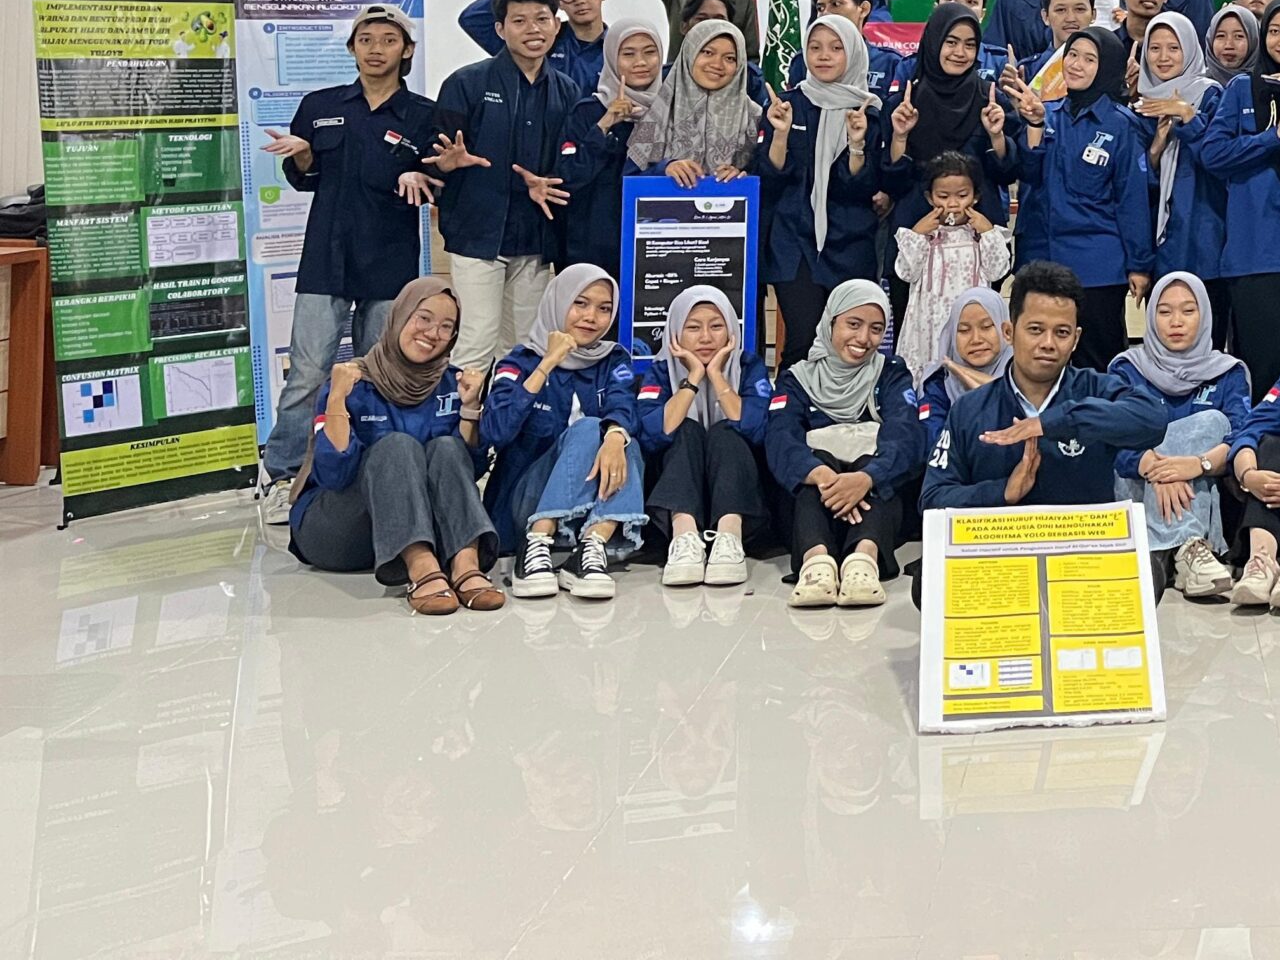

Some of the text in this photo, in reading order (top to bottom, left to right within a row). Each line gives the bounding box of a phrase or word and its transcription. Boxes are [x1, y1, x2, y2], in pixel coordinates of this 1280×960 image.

[244, 3, 315, 11] MENGGUNAKAN
[168, 134, 213, 142] TEKNOLOGI
[65, 145, 99, 153] TUJUAN
[151, 204, 232, 215] METODE PENELITIAN
[56, 216, 129, 227] MANFAAT SISTEM
[153, 275, 245, 289] HASIL TRAIN DI GOOGLE
[167, 287, 231, 300] COLABORATORY
[55, 293, 137, 308] KERANGKA BERPIKIR
[194, 349, 223, 360] RECALL
[222, 347, 250, 355] CURVE
[61, 366, 140, 382] CONFUSION MATRIX
[130, 436, 181, 451] KESIMPULAN
[936, 429, 951, 449] 20
[929, 448, 949, 469] 24
[973, 532, 1022, 540] ALGORITMA
[1047, 530, 1086, 538] BERBASIS
